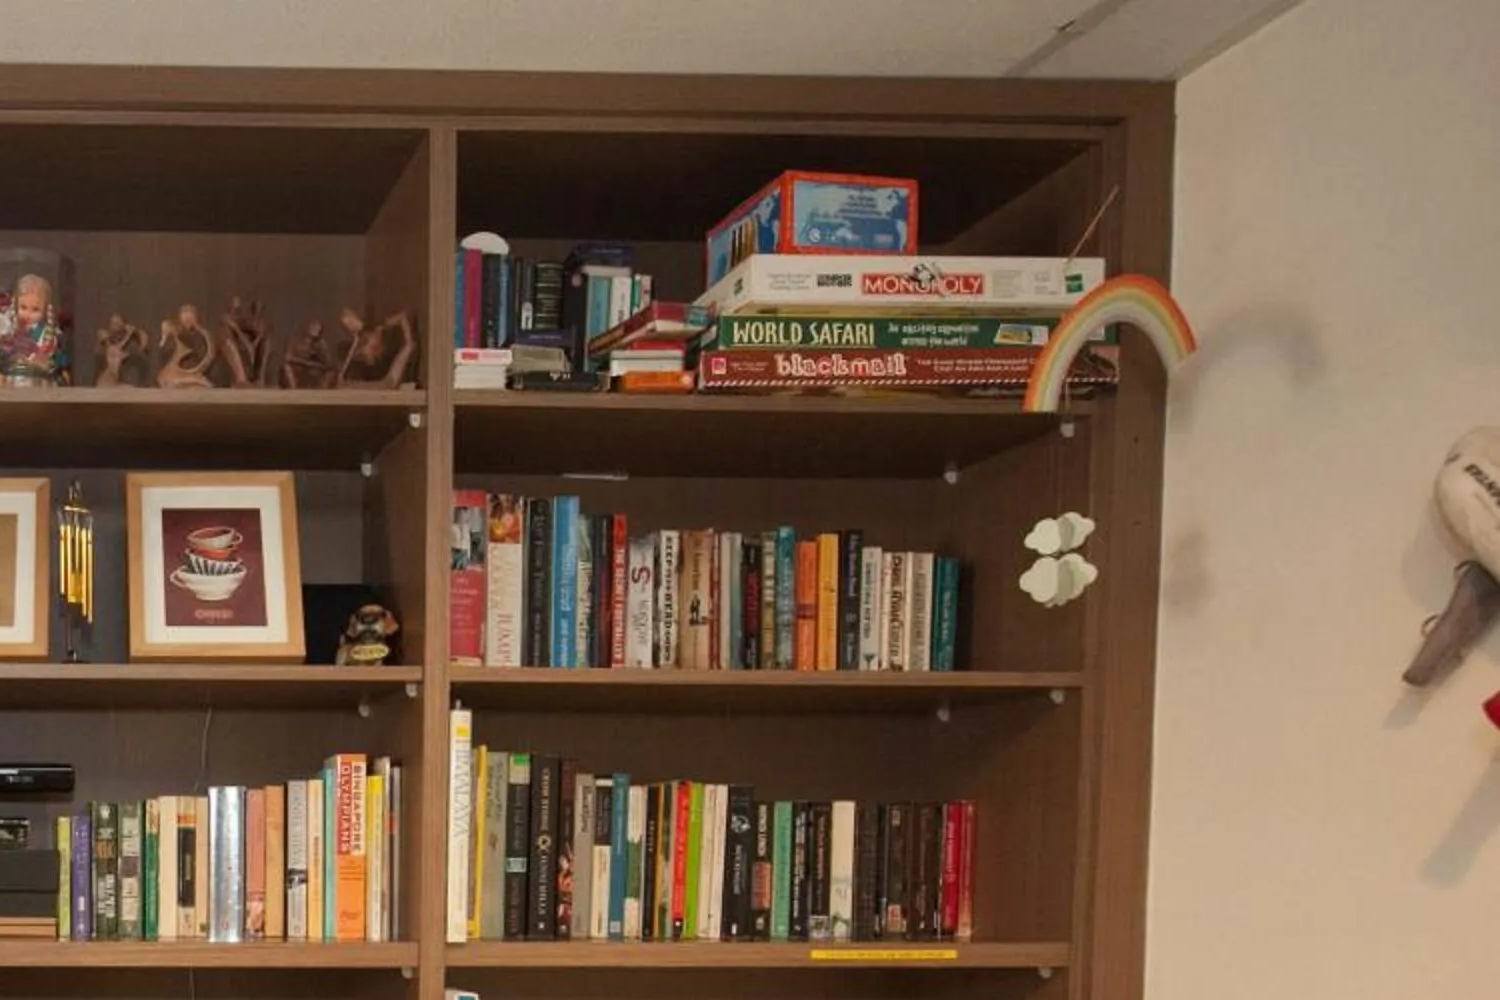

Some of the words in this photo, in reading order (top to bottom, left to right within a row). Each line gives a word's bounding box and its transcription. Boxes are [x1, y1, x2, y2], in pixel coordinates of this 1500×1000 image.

[864, 277, 980, 294] MONOOLY
[732, 321, 803, 345] WORLD
[809, 322, 875, 345] SAFARI
[775, 353, 907, 377] blackmail
[340, 764, 350, 852] OLYMPIANS
[352, 764, 363, 852] SINGAPORE
